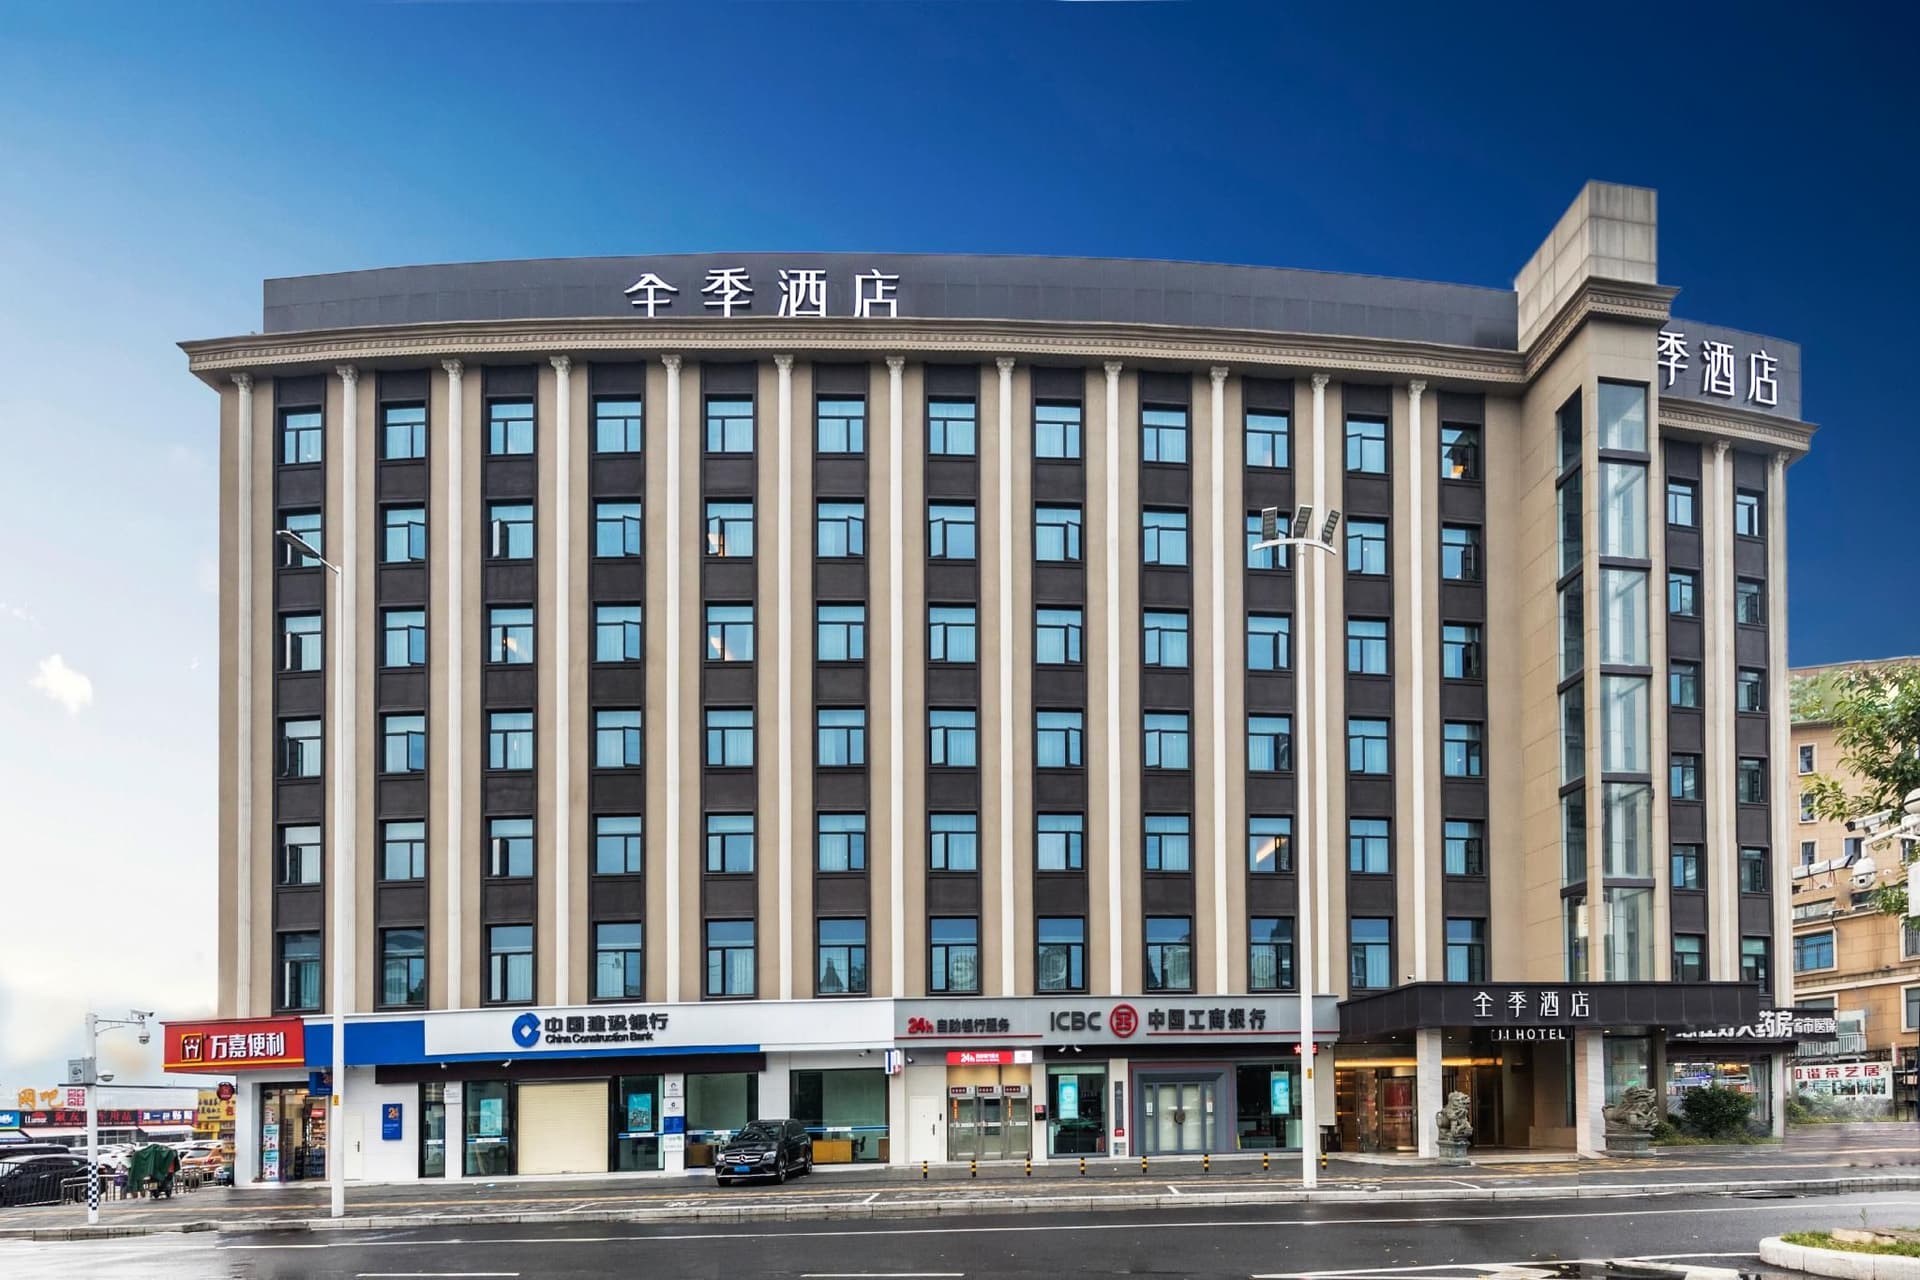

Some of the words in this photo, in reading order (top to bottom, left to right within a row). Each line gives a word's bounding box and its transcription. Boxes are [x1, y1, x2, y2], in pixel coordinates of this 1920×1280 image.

[624, 267, 899, 317] 全季酒店
[1657, 331, 1778, 405] 季酒店
[1472, 990, 1590, 1018] 全季酒店
[545, 1013, 669, 1032] 中国建设银行
[908, 1018, 934, 1034] 24h
[937, 1018, 1010, 1033] 自助银行服务
[1051, 1011, 1102, 1032] ICBC
[1148, 1008, 1266, 1031] 中国工商银行
[210, 1032, 285, 1059] 万嘉便利
[545, 1034, 571, 1044] China
[572, 1031, 629, 1044] Construction
[630, 1031, 653, 1042] Bank
[1516, 1029, 1566, 1040] HOTEL
